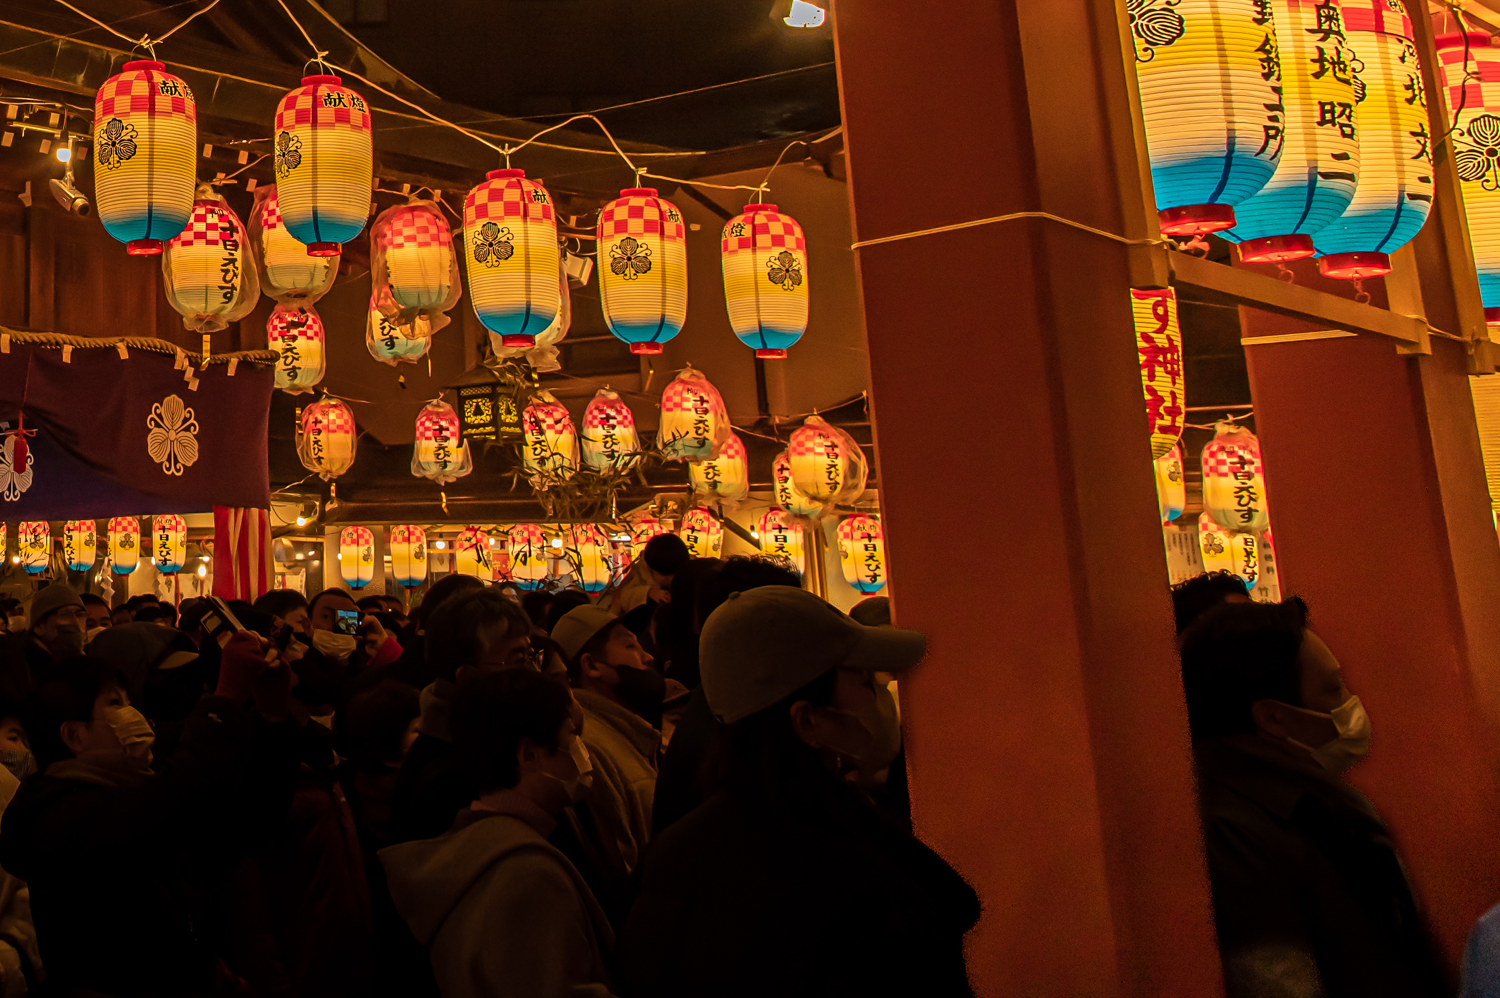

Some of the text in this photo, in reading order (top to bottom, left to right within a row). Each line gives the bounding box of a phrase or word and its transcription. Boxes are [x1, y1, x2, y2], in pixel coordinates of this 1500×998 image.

[322, 92, 367, 113] 献燈
[218, 220, 240, 305] 十日えびす
[279, 318, 303, 382] 十日えびす
[311, 417, 325, 466] 十日えびす
[432, 422, 451, 471] 十日えびす
[600, 412, 619, 461] 十日えびす
[692, 395, 710, 449] 十日えびす
[776, 463, 794, 510] 十日えびす
[824, 440, 840, 494] 十日えびす
[1228, 455, 1260, 523] 十日えびす
[64, 526, 76, 565] 十日えびす
[158, 525, 172, 566] 十日えびす
[860, 533, 882, 584] 十日えびす
